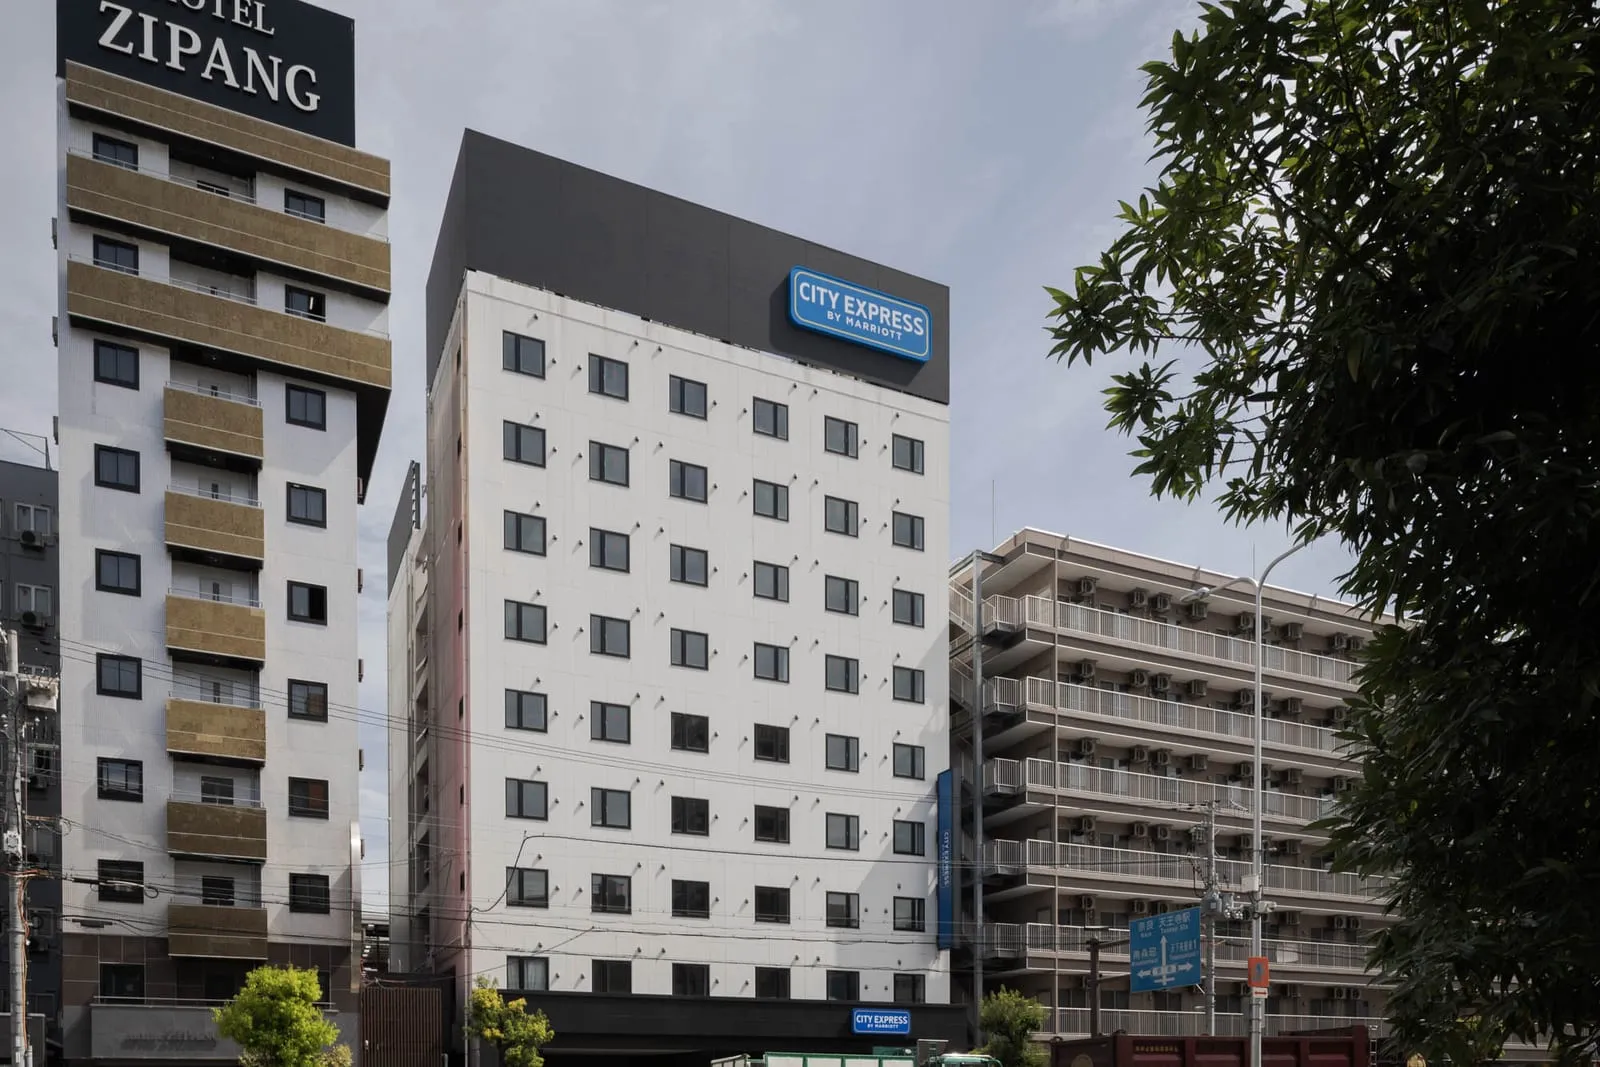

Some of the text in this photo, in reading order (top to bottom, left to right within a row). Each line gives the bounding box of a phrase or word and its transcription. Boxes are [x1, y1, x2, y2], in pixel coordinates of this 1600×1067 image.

[97, 1, 321, 112] ZIPANG
[799, 282, 924, 336] CITY EXPRESS
[827, 310, 902, 340] BY MARRIOTT
[856, 1014, 908, 1024] CITY EXPRESS
